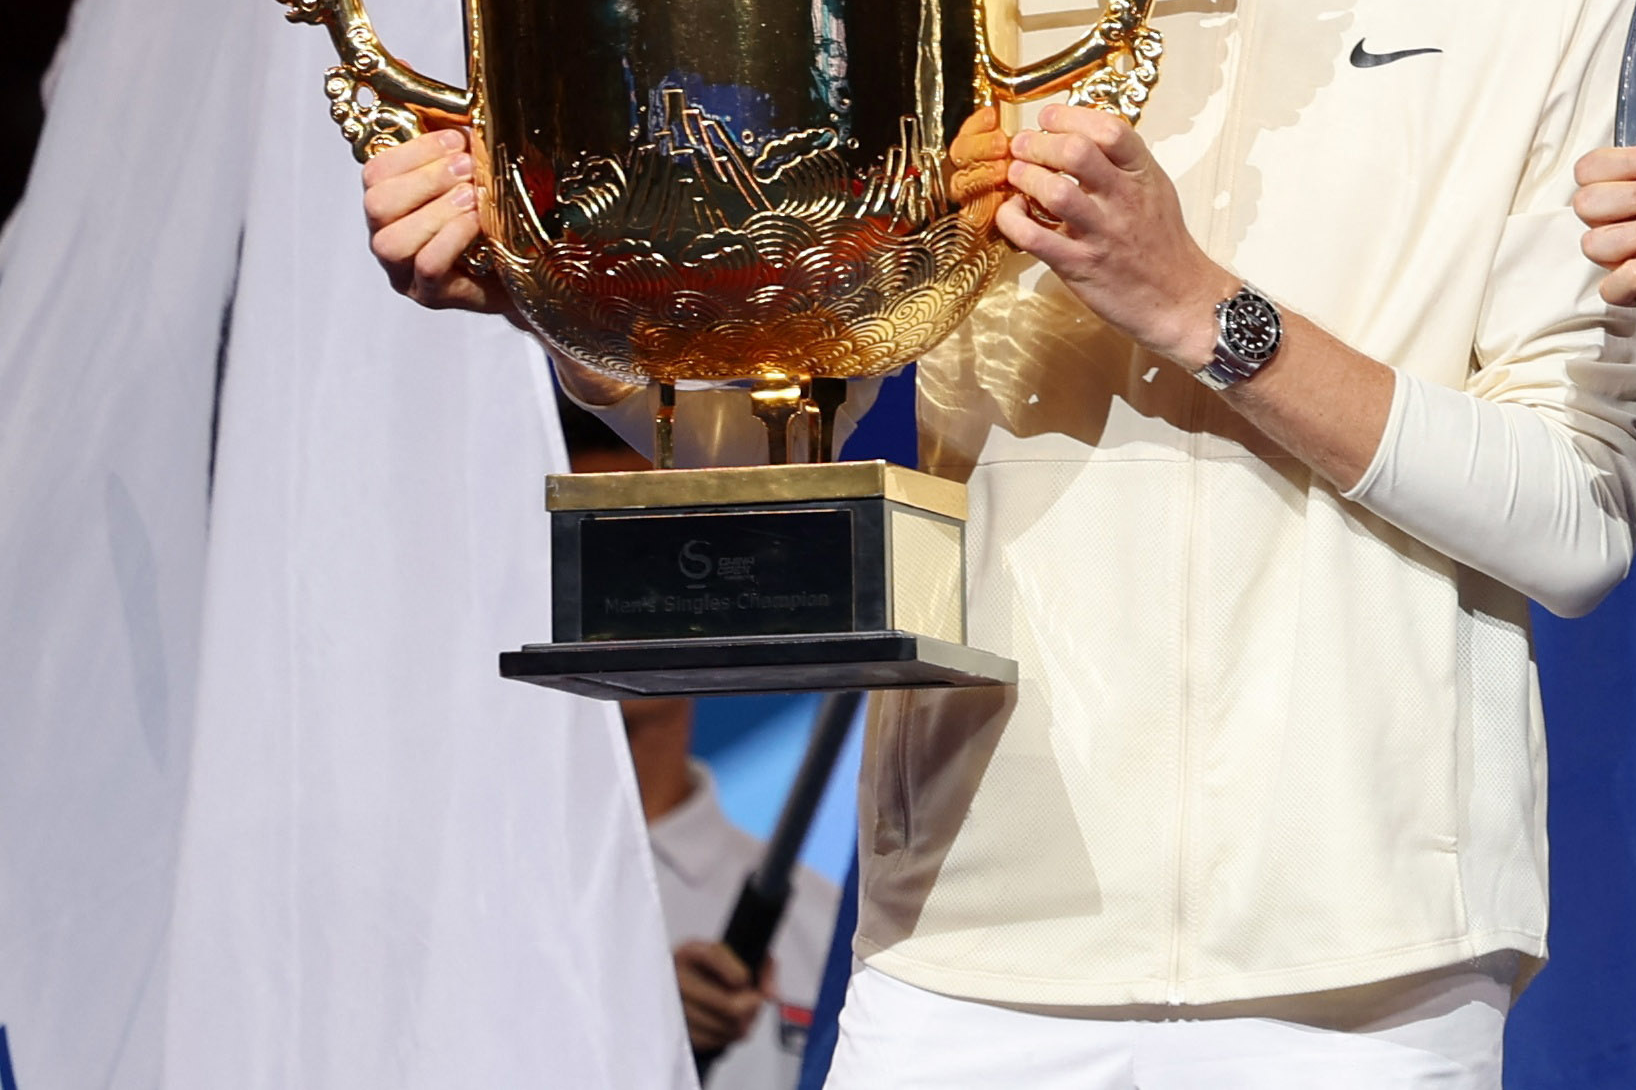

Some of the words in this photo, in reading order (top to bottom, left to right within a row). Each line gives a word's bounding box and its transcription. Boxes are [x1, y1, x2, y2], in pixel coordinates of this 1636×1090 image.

[604, 594, 657, 615] Men's
[662, 593, 731, 615] Singles
[735, 590, 832, 612] Champion
